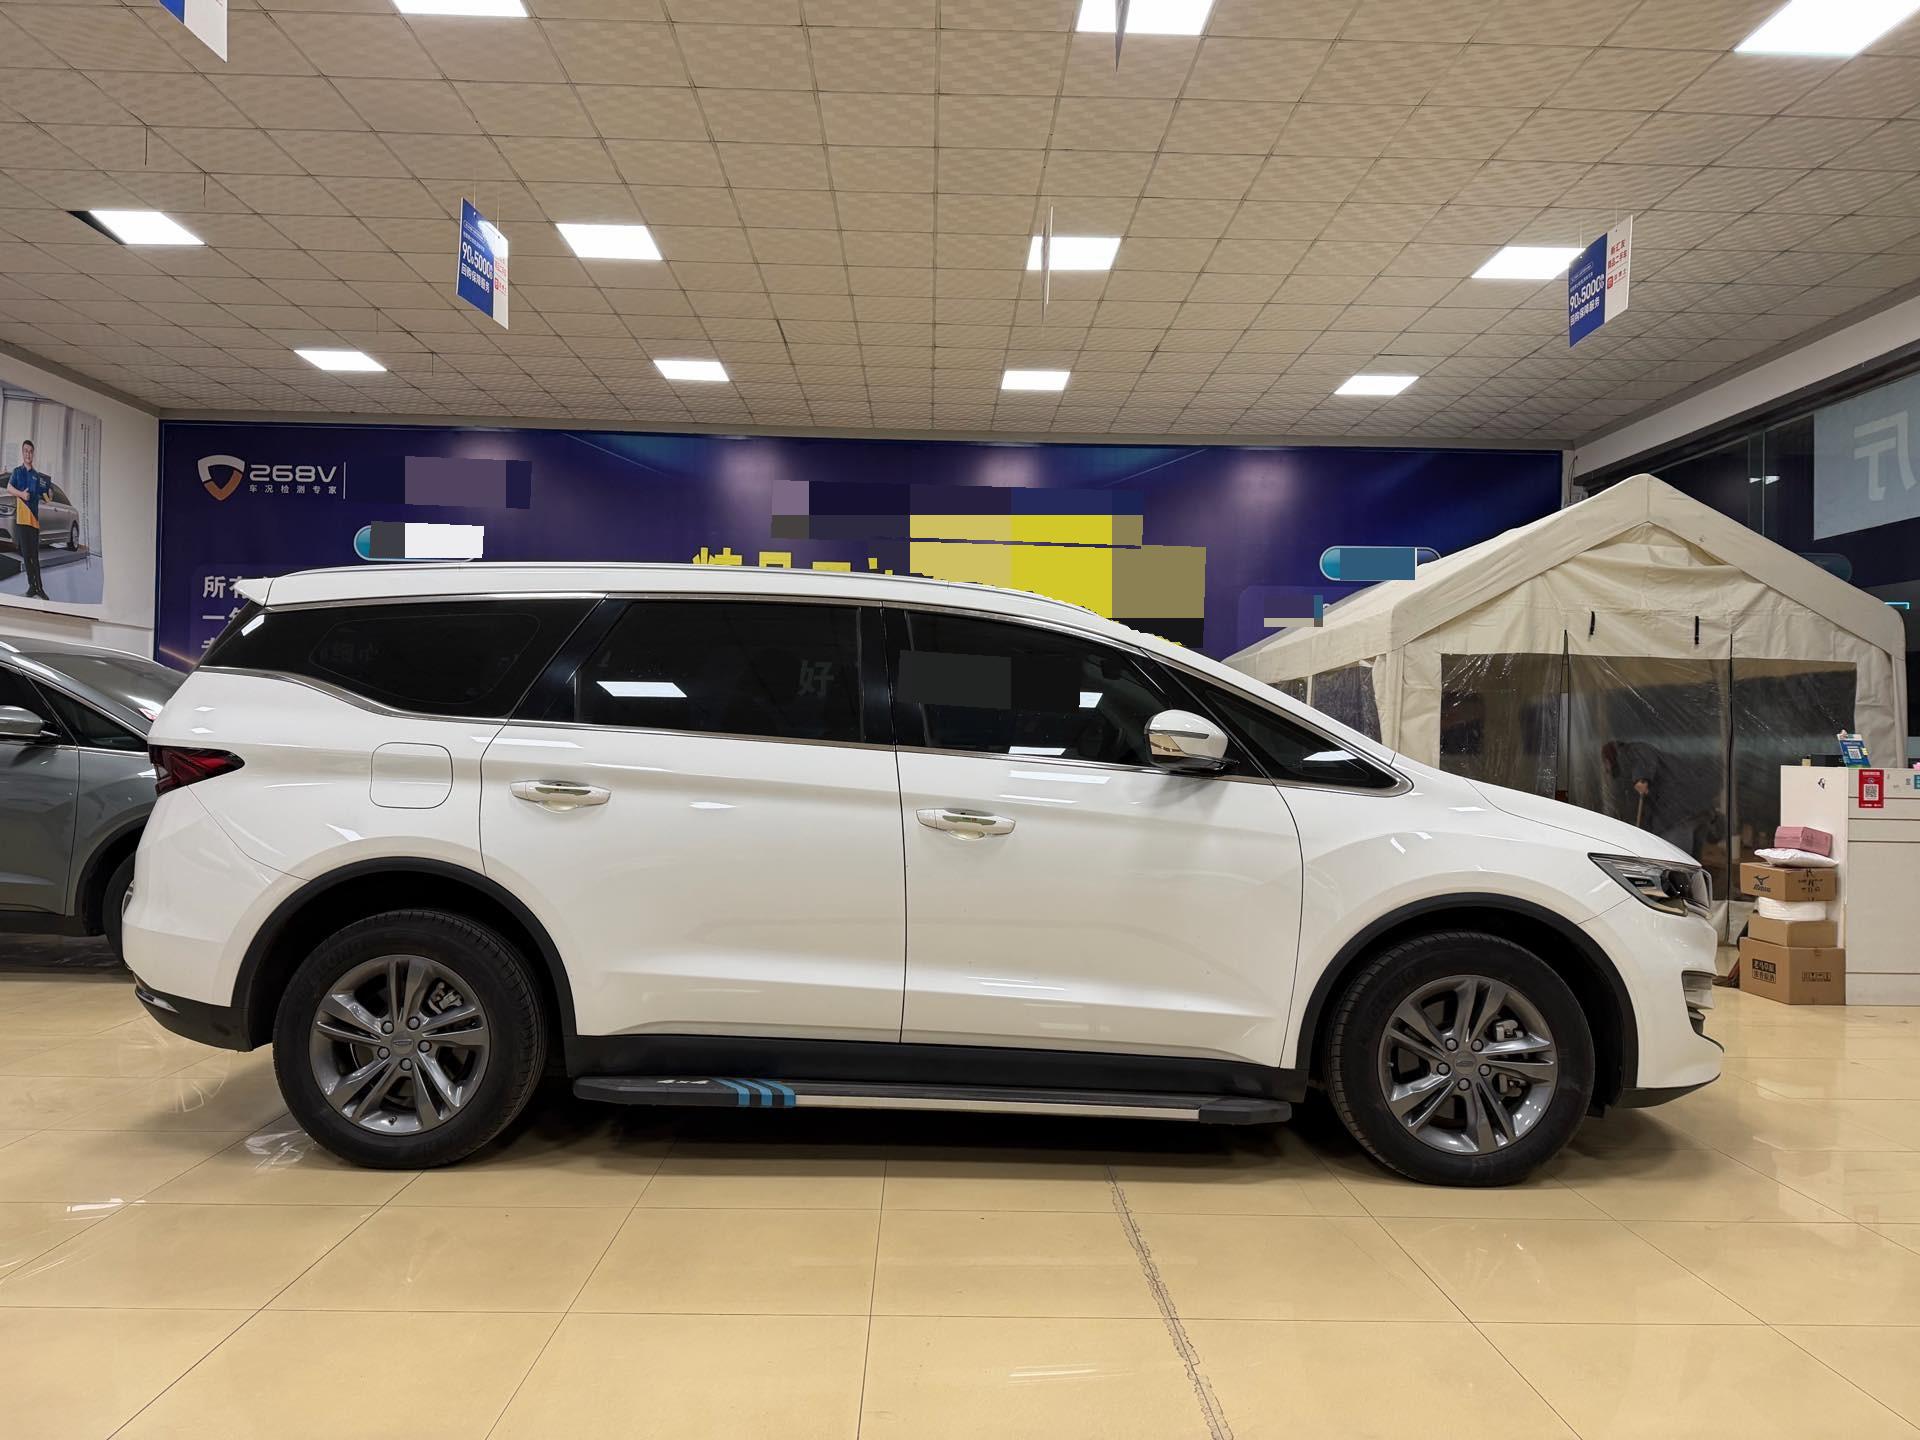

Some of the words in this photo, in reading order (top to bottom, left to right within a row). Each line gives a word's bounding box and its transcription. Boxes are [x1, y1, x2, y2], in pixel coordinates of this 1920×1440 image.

[249, 464, 337, 483] 268V
[249, 484, 337, 495] 车况检测专家
